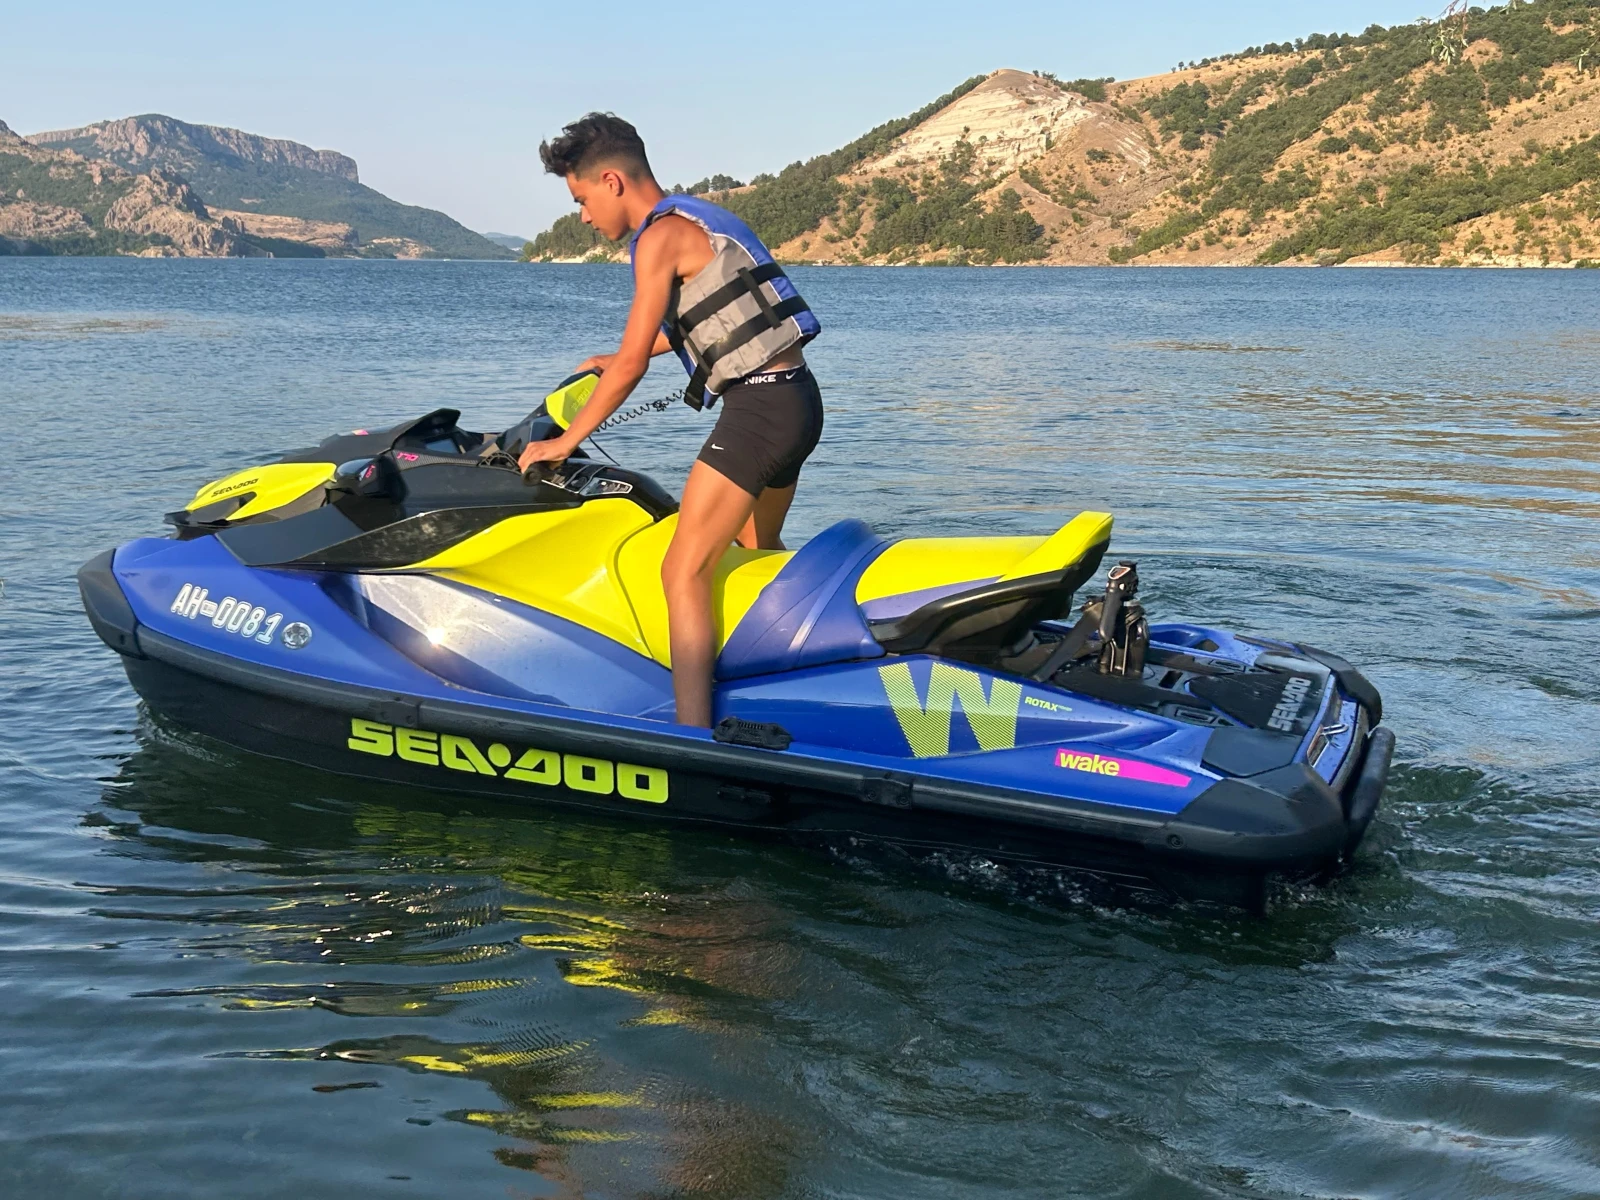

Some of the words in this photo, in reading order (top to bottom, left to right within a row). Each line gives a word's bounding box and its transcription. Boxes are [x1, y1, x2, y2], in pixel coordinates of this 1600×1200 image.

[744, 374, 777, 385] NIKE
[171, 583, 283, 645] AH-0081
[878, 661, 1023, 759] W
[1024, 696, 1058, 712] ROTAX
[1059, 752, 1120, 777] wake
